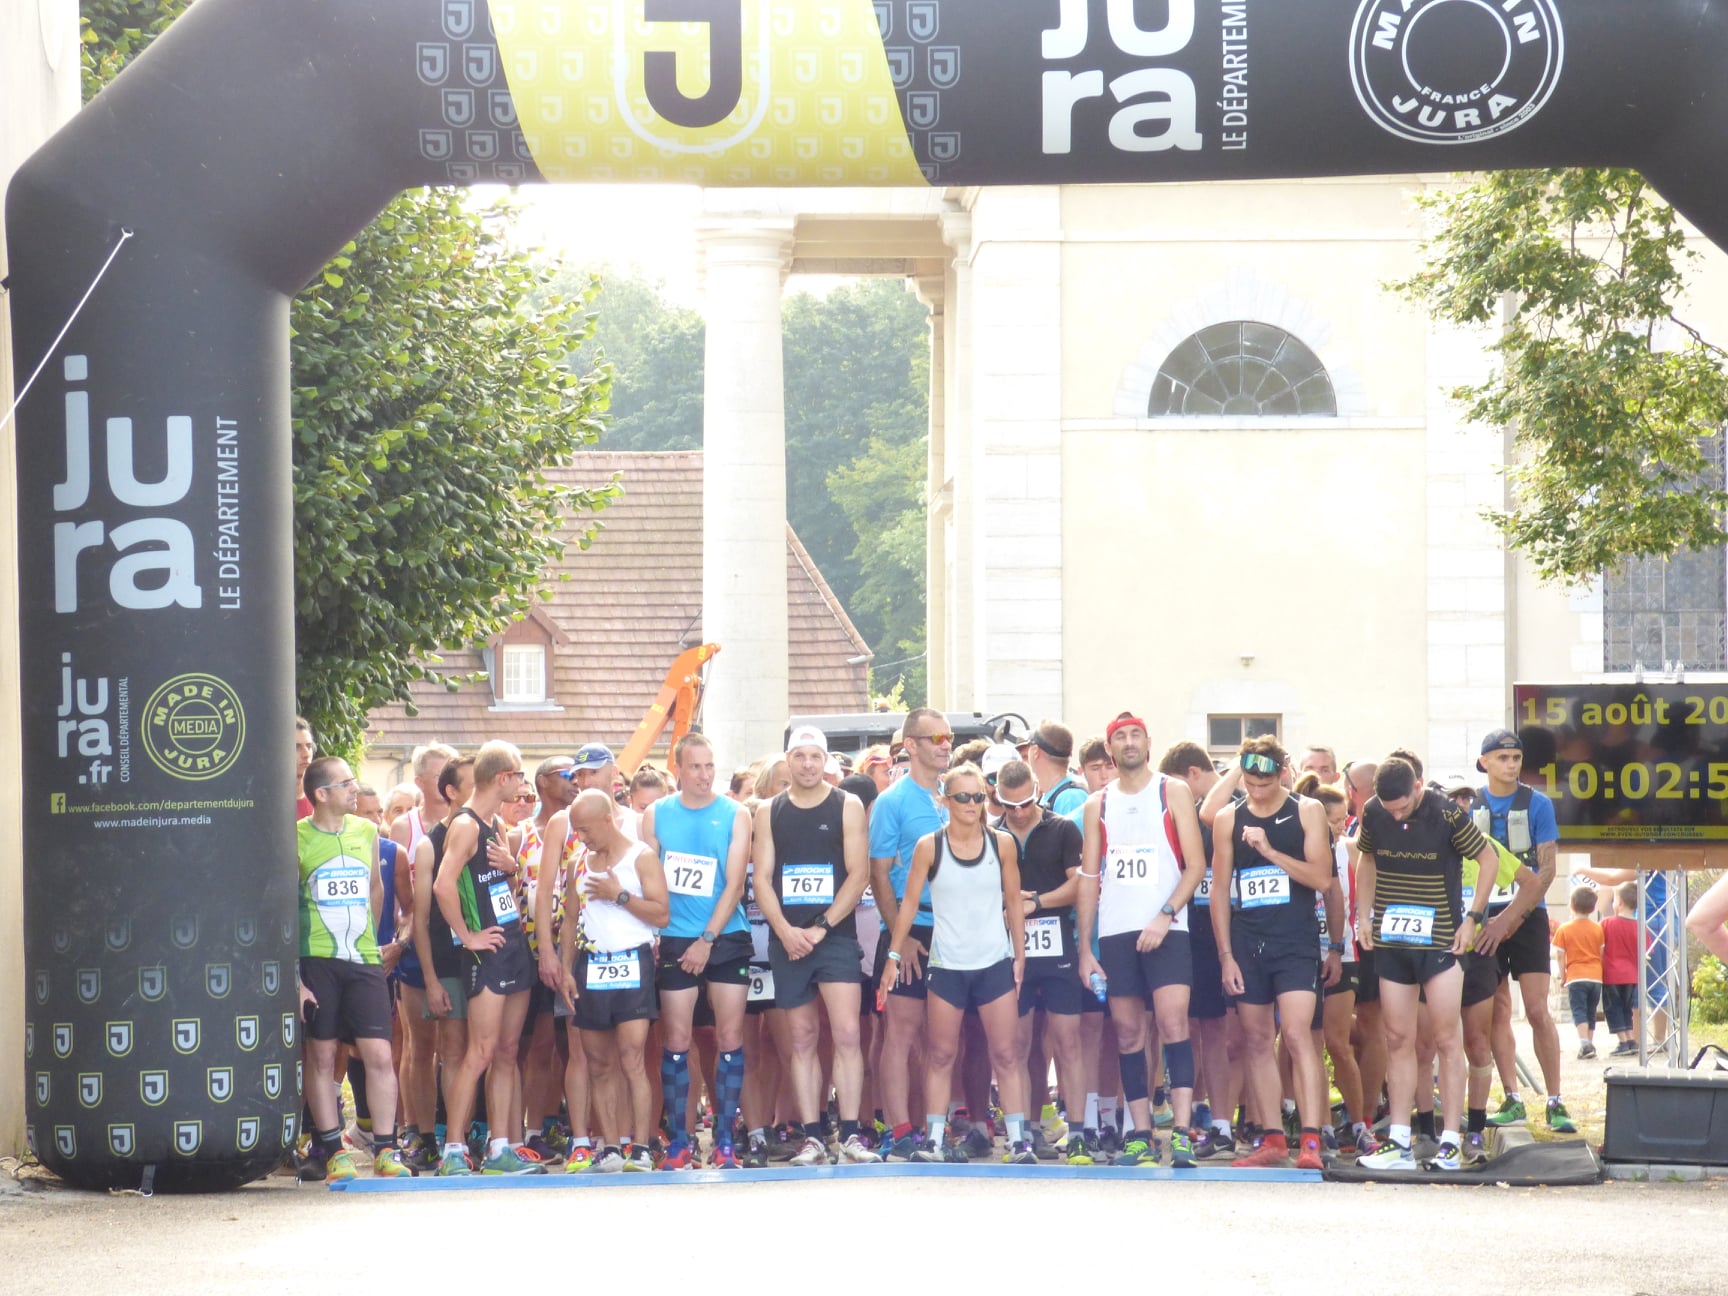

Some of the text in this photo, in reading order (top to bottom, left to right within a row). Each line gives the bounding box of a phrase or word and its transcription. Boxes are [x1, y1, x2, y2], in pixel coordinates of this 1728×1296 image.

[1216, 0, 1248, 150] LE DÉPARTEM
[1420, 83, 1491, 104] FRANCE
[1042, 67, 1203, 154] ra
[1391, 93, 1518, 129] JURA
[53, 354, 194, 511] ju
[213, 416, 241, 610] LE DÉPARTEMENT
[54, 517, 203, 613] ra
[57, 652, 109, 717] ju
[153, 684, 237, 727] MADE IN
[1522, 697, 1567, 726] 15
[1581, 693, 1671, 726] août
[57, 719, 112, 758] ra
[117, 676, 131, 783] CONSEIL DÉPARTEMENTAL
[174, 719, 218, 734] MEDIA
[163, 748, 227, 770] JURA
[78, 759, 113, 784] .fr
[1539, 762, 1728, 800] 10:02:5
[68, 799, 255, 814] www.facebook.com/departementdujura
[93, 815, 212, 829] www.madeinjura.media
[673, 866, 703, 890] 172
[794, 867, 831, 875] BROOKS
[1116, 858, 1148, 879] 210
[327, 880, 359, 896] 836
[790, 878, 824, 893] 767
[1247, 878, 1280, 896] 812
[1390, 916, 1423, 933] 773
[1024, 930, 1052, 951] 215
[597, 964, 630, 980] 793
